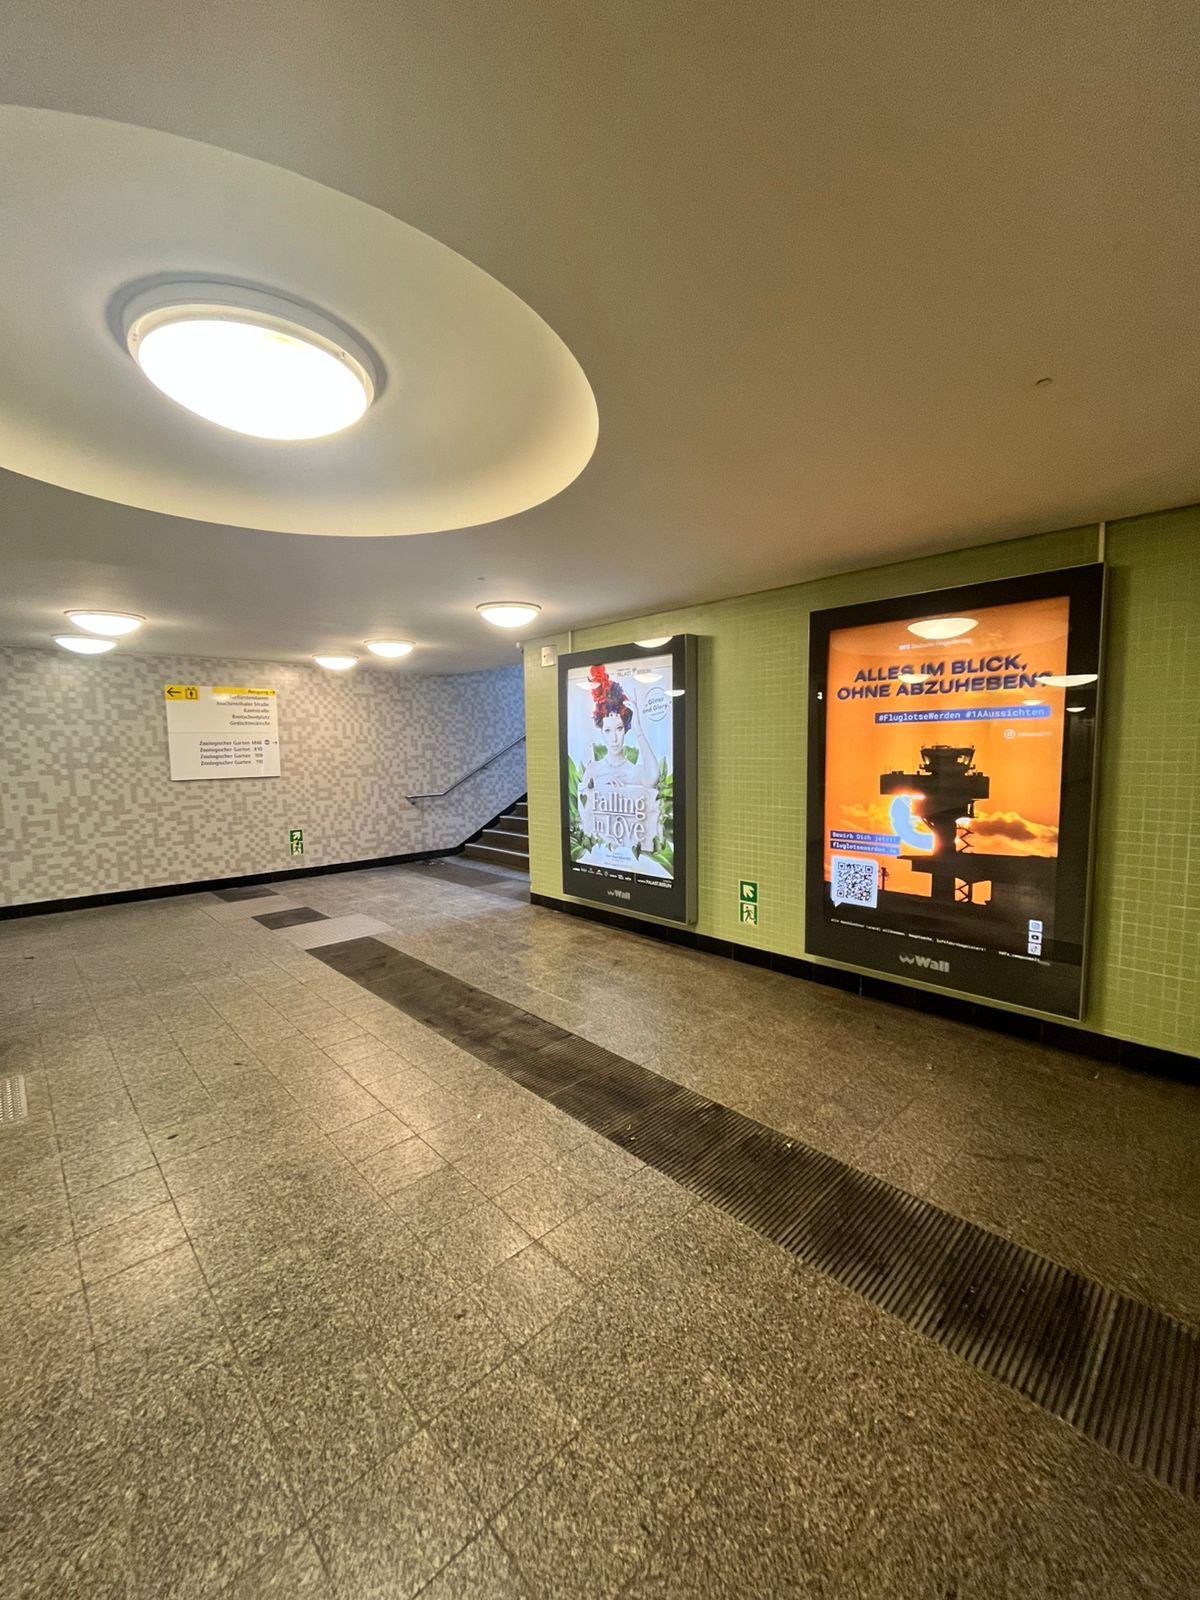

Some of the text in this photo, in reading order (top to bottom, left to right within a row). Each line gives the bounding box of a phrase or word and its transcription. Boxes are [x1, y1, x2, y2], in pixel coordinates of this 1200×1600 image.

[854, 653, 1028, 682] ALLES IM BLICK,
[836, 684, 892, 700] OHNE
[642, 705, 652, 714] and
[653, 703, 668, 711] Glory
[878, 707, 1045, 723] #FluglotseWerden #1AAussichten
[592, 791, 646, 821] Falling
[592, 815, 646, 846] in Love
[615, 889, 631, 900] Wall
[915, 955, 950, 973] Wall
